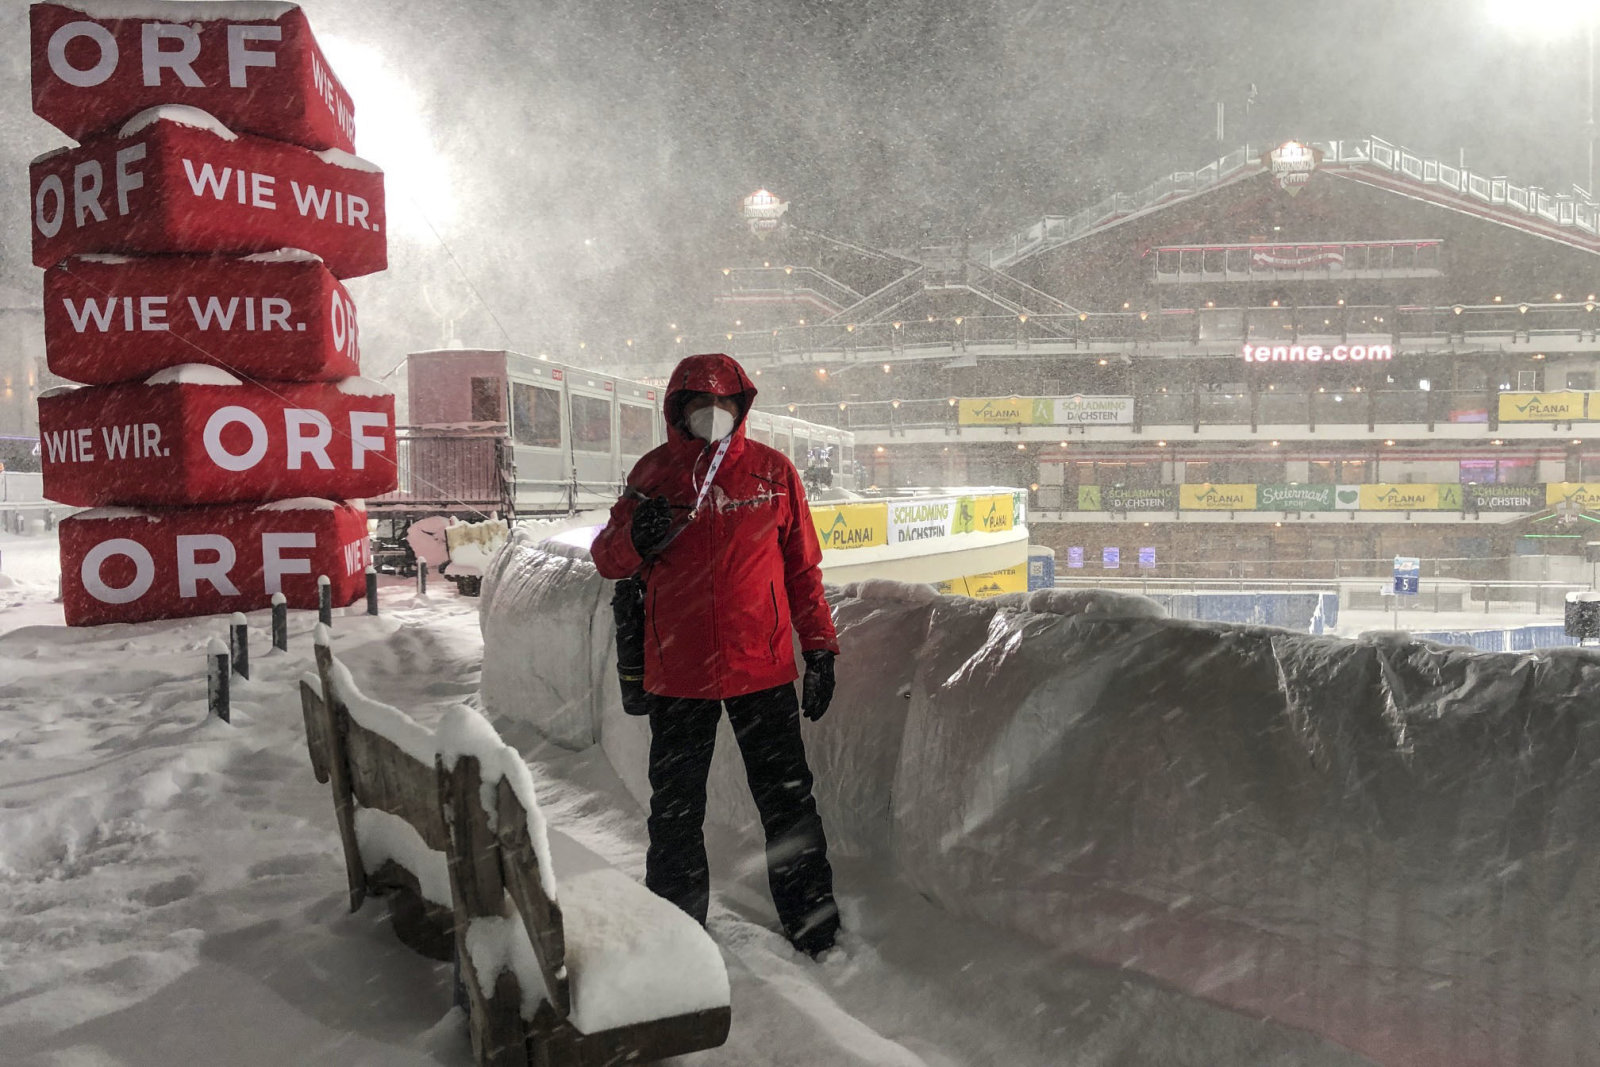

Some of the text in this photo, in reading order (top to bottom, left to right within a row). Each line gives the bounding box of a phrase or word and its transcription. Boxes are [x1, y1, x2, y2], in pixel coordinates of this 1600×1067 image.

[47, 21, 283, 88] ORF
[311, 50, 335, 115] WIE
[35, 142, 147, 239] ORF
[182, 158, 380, 232] WIE WIR.
[62, 296, 307, 333] WIE WIR.
[1243, 343, 1393, 362] tenne.com
[984, 410, 1020, 418] PLANAI
[1062, 401, 1126, 411] SCHLADMING
[1529, 405, 1569, 413] PLANAI
[1067, 412, 1118, 421] DACHSTEIN
[44, 428, 94, 464] WIE
[102, 422, 170, 460] WIR.
[203, 405, 389, 472] ORF
[1114, 498, 1165, 508] DACHSTEIN
[1206, 495, 1244, 503] PLANAI
[1263, 488, 1329, 505] Steiermark
[1388, 495, 1425, 503] PLANAI
[1477, 497, 1531, 508] DACHSTEIN
[893, 503, 949, 525] SCHLADMING
[833, 527, 873, 545] PLANAI
[81, 532, 317, 604] ORF
[1403, 578, 1409, 590] 5
